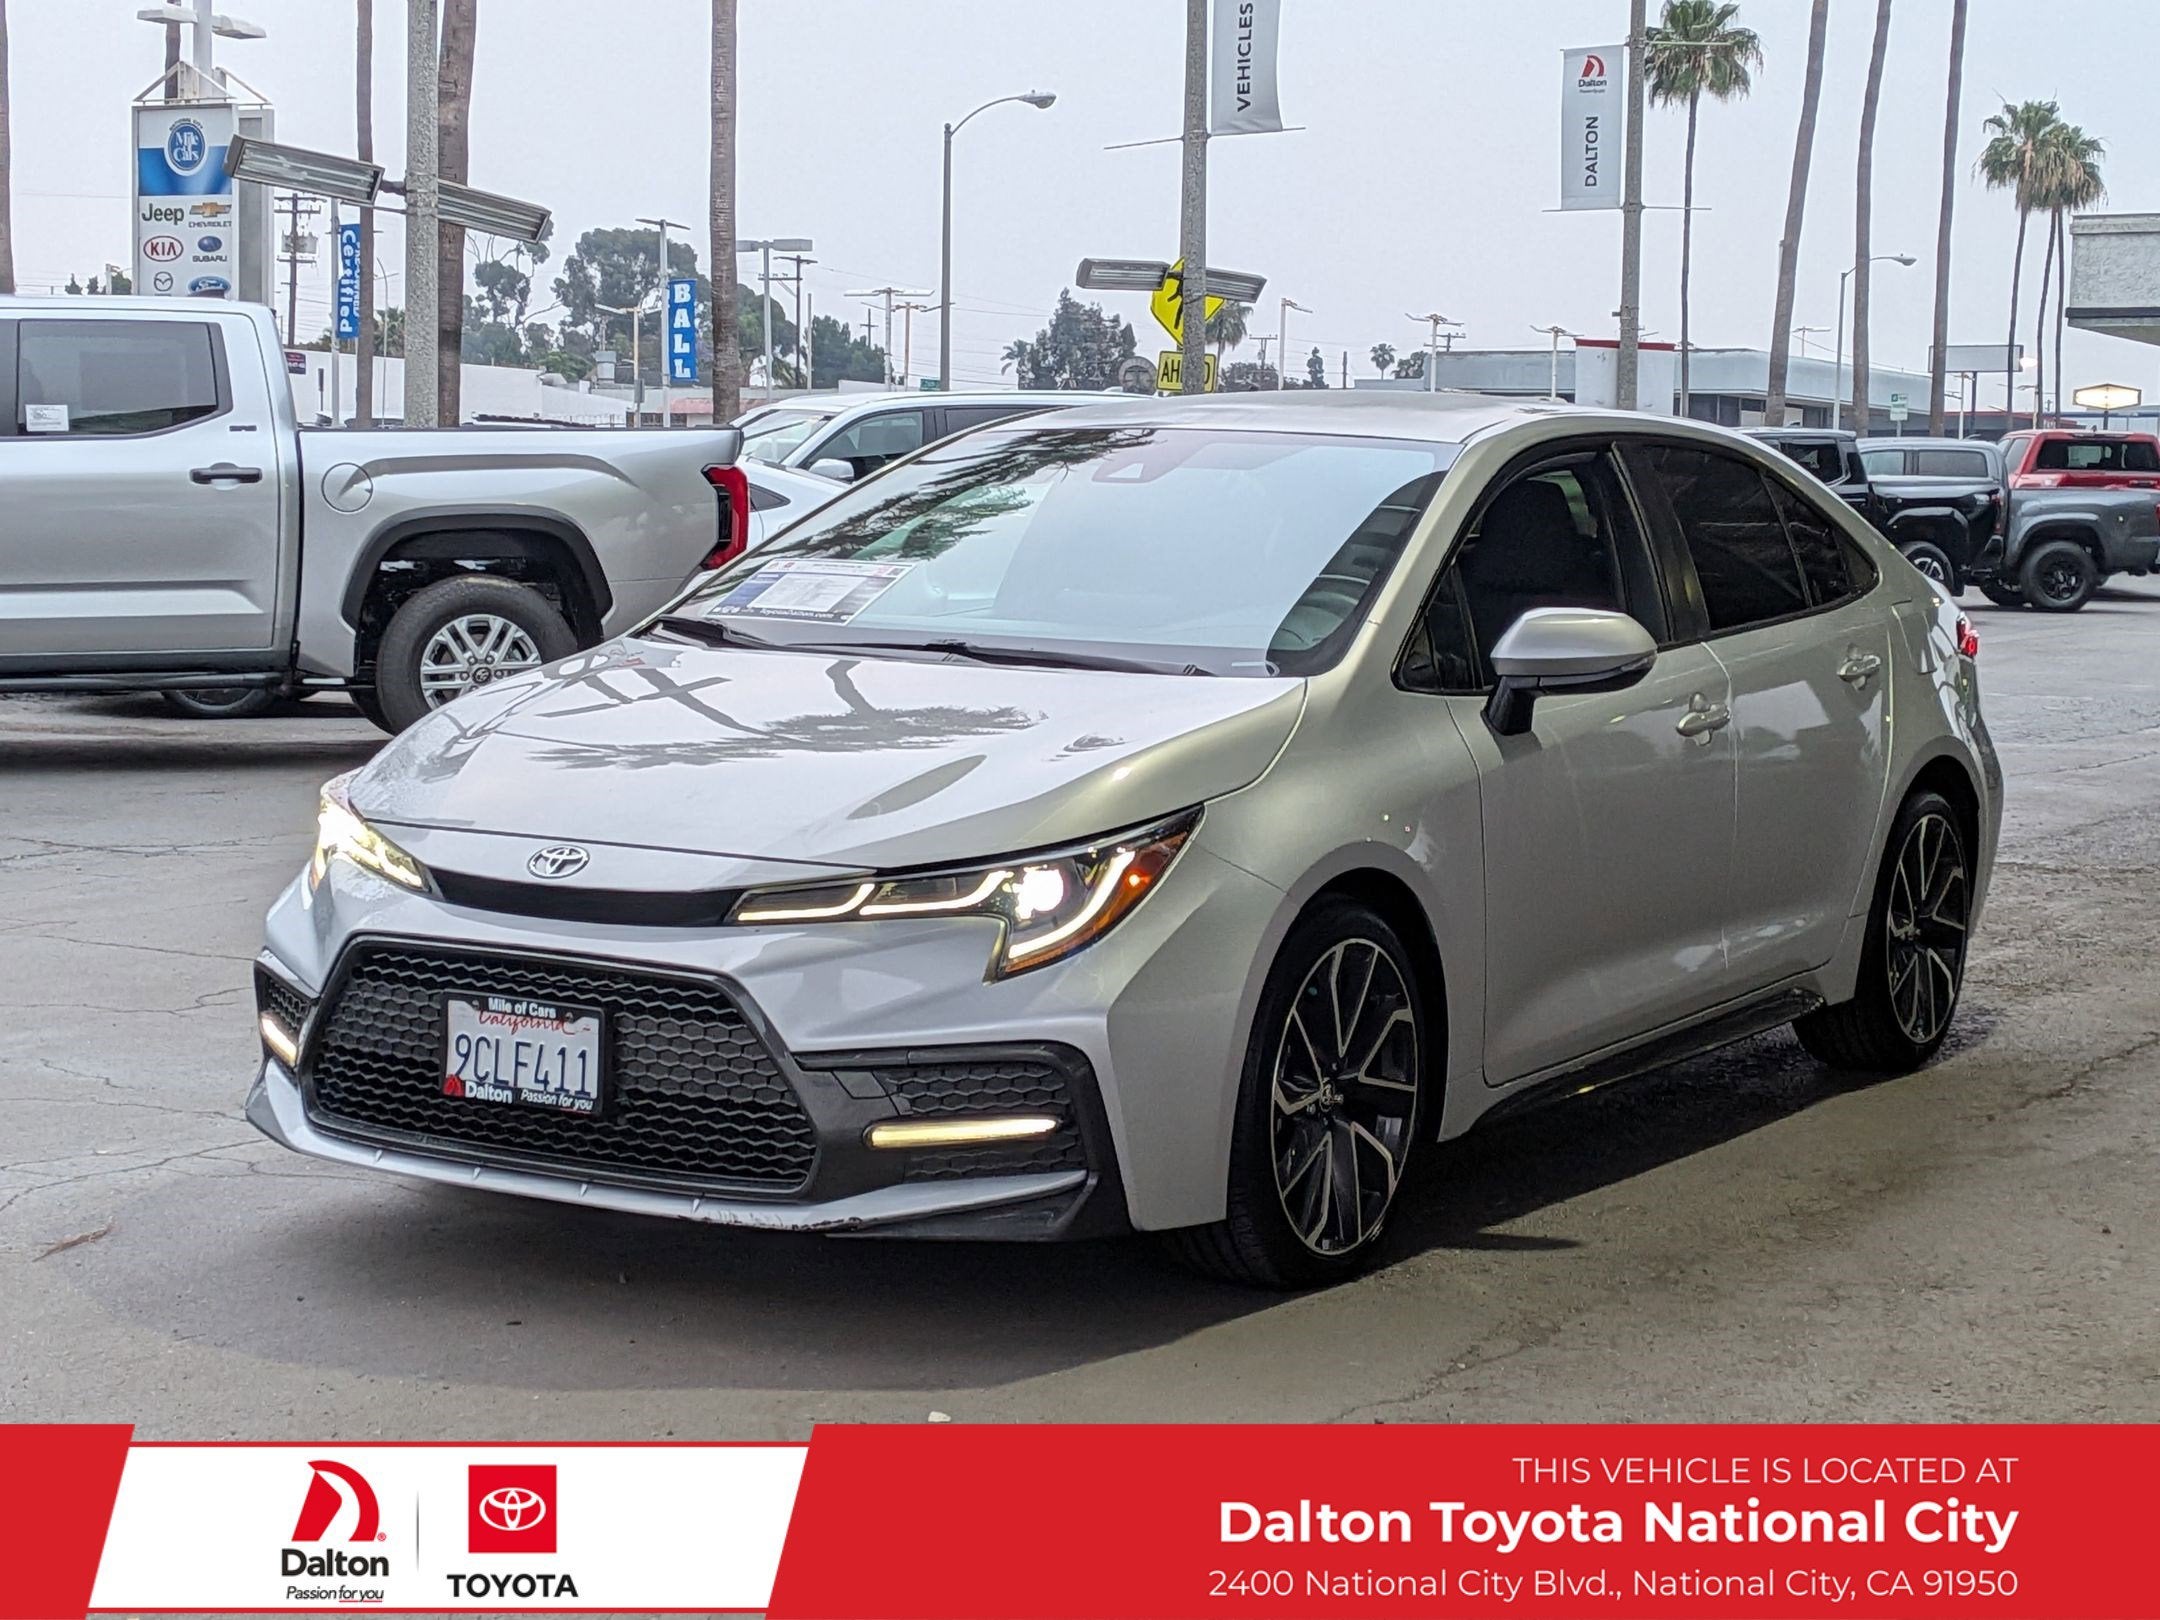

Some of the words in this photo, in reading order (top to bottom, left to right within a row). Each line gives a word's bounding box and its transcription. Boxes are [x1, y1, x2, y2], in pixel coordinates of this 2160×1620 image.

[1237, 2, 1253, 112] VEHICLES
[1585, 116, 1598, 186] DALTON
[141, 203, 185, 225] Jeep
[150, 242, 177, 256] KIA
[340, 230, 356, 332] Certified
[673, 284, 691, 378] BALL
[1160, 359, 1210, 385] AHD
[488, 997, 512, 1013] Mile
[514, 1002, 527, 1015] of
[529, 1003, 556, 1019] Cars
[455, 1033, 592, 1098] 9CLF411
[465, 1080, 512, 1104] Dalton
[520, 1088, 557, 1106] Passion
[558, 1092, 573, 1107] for
[573, 1097, 594, 1111] you
